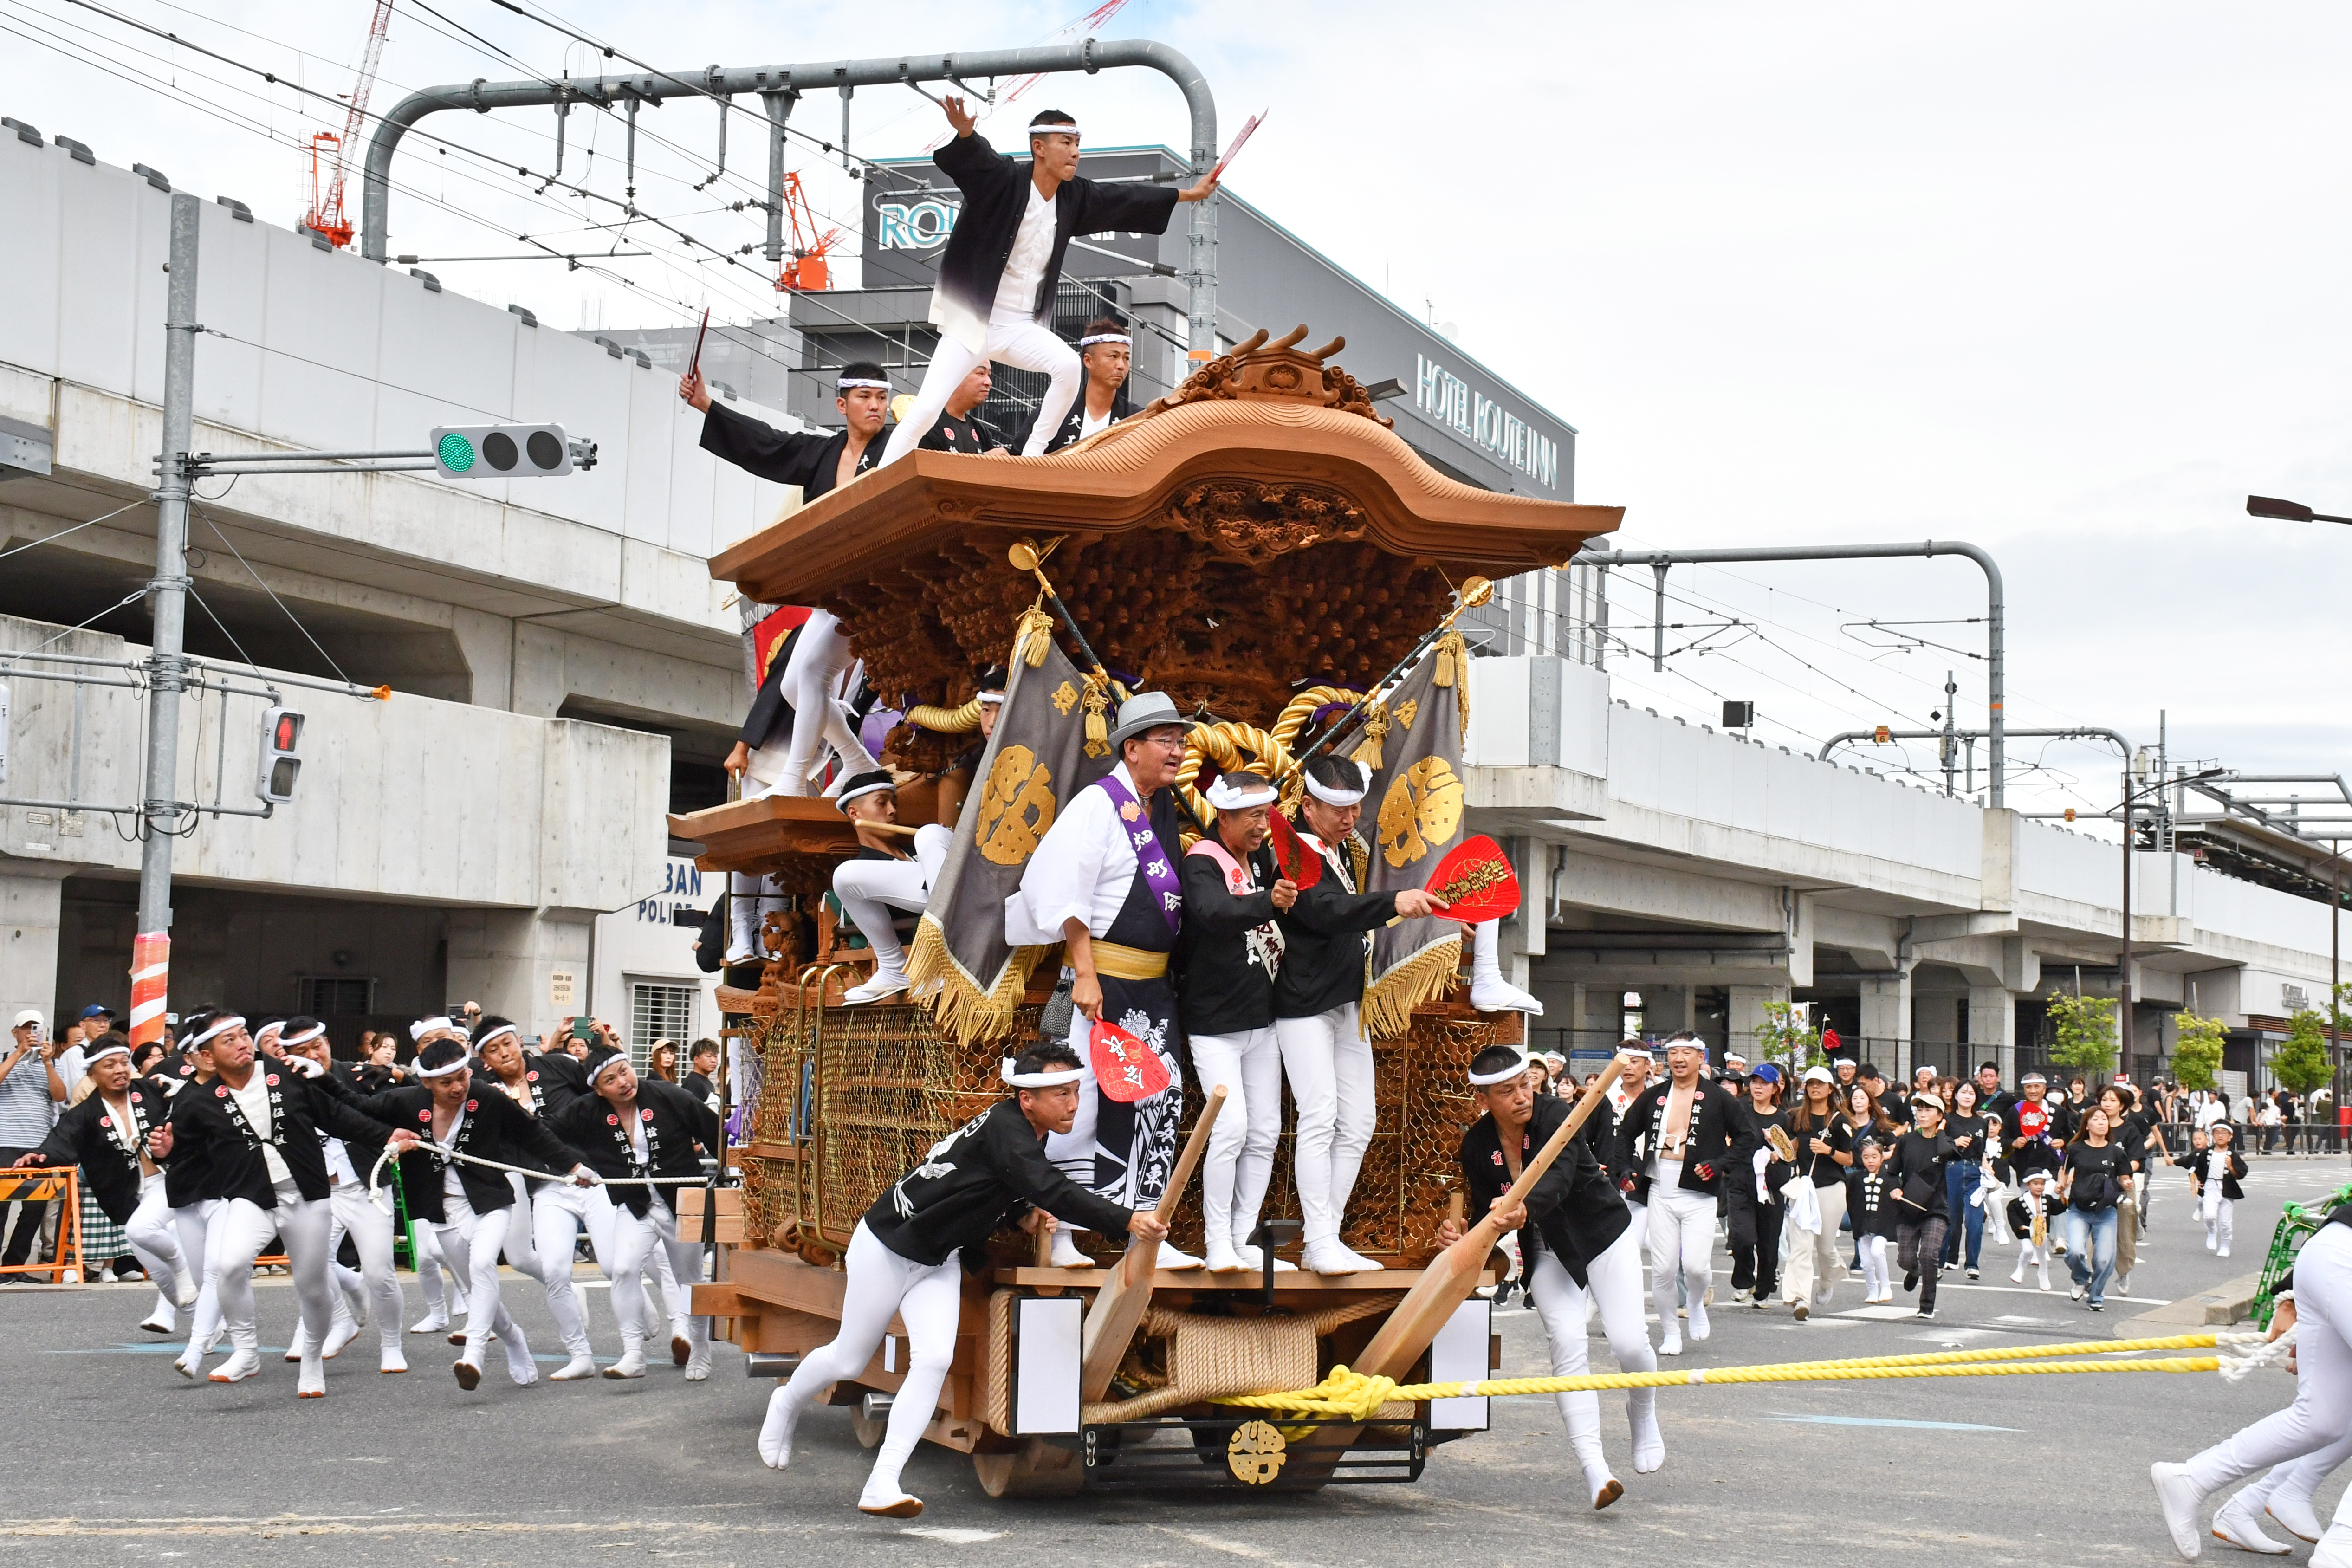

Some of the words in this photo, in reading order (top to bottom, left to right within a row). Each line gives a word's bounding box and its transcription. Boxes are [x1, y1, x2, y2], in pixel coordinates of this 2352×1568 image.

[1417, 353, 1472, 439] HOTEL
[1473, 391, 1527, 472] ROUTE
[1526, 425, 1557, 491] INN
[1133, 829, 1183, 936] 畑町会
[639, 900, 692, 924] POLI
[1100, 1035, 1145, 1089] 会長
[269, 1091, 288, 1146] 拾伍人組
[1685, 1104, 1702, 1147] 拾伍人組
